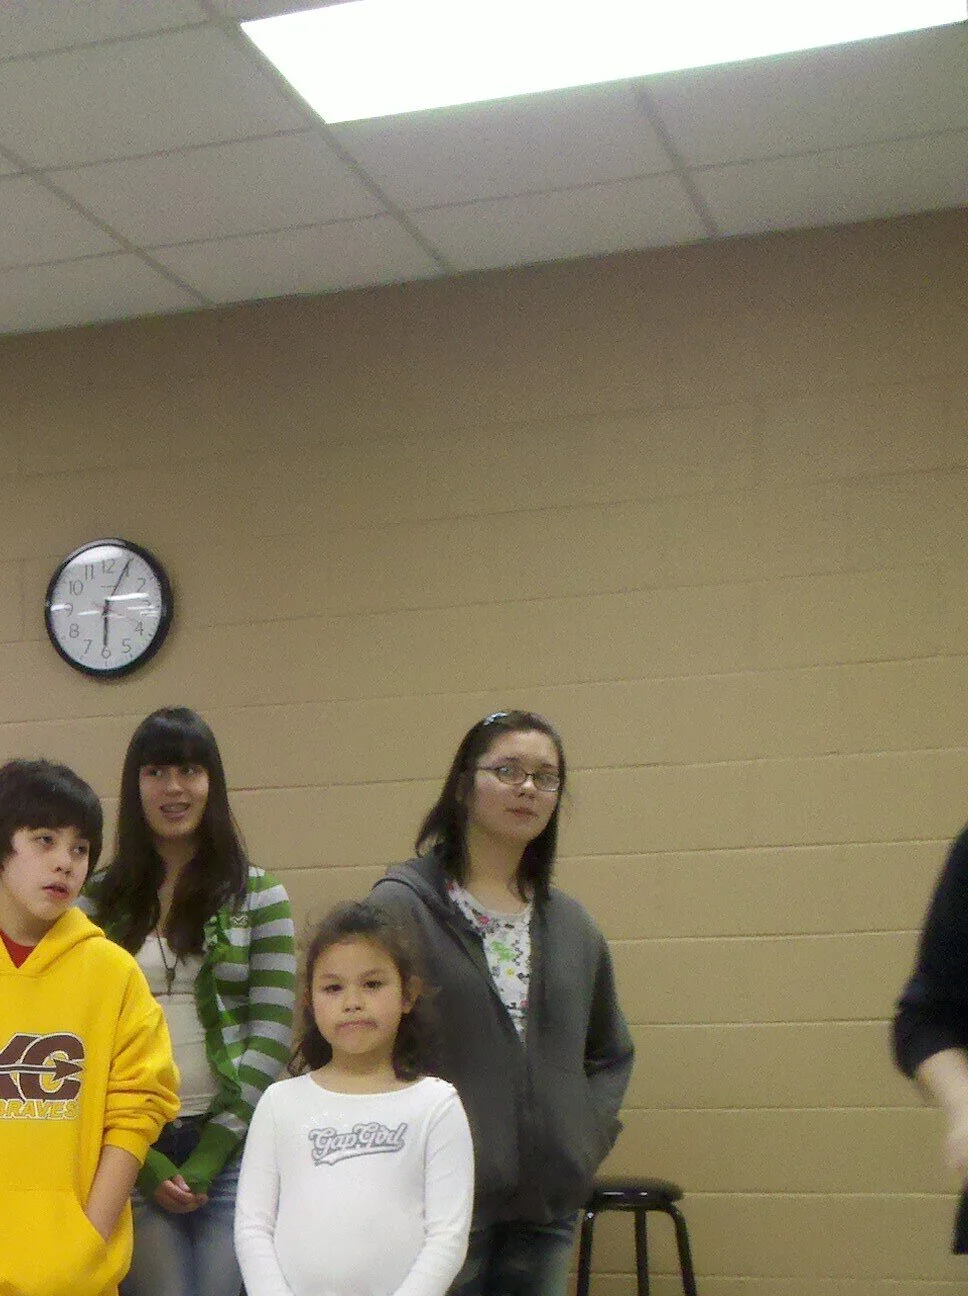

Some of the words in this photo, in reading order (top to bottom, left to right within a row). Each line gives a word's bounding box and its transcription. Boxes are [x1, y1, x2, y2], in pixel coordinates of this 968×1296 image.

[85, 564, 94, 580] 11
[102, 559, 116, 574] 12
[69, 579, 84, 596] 10
[69, 623, 80, 638] 8
[136, 621, 145, 636] 4
[84, 639, 94, 654] 7
[102, 645, 112, 659] 6
[122, 638, 132, 653] 5
